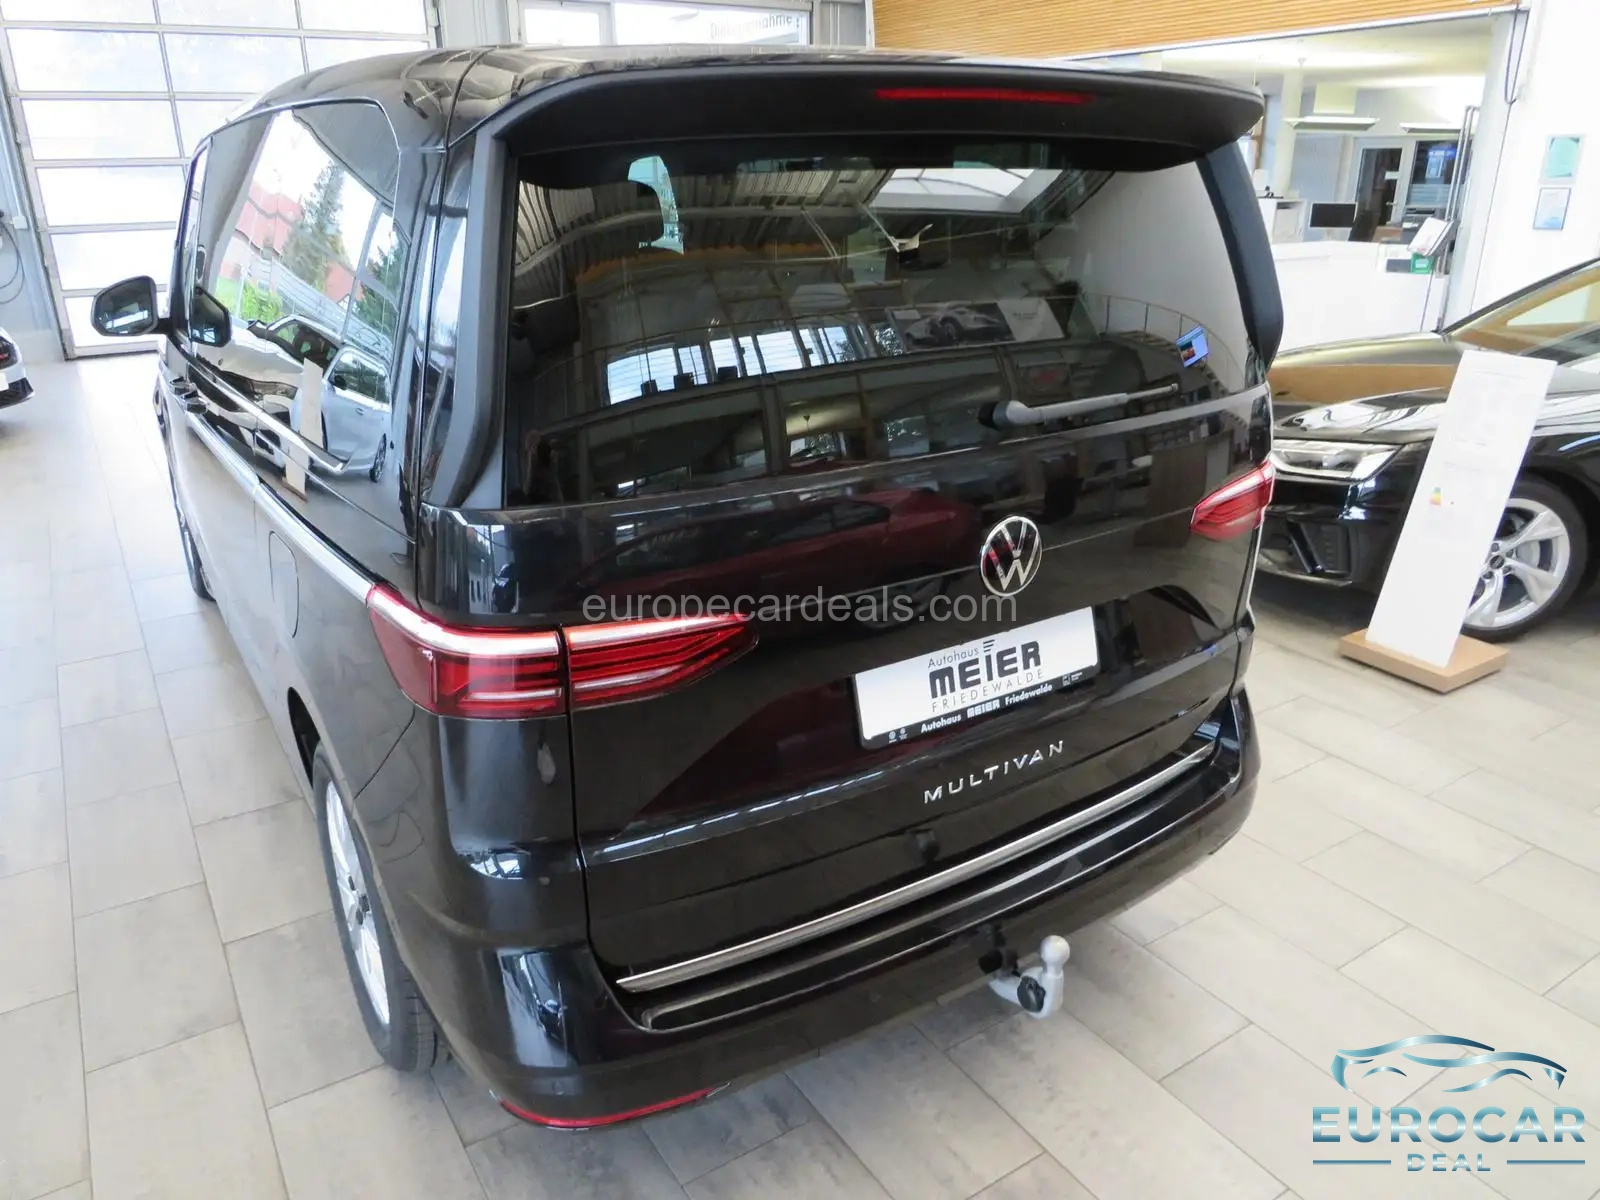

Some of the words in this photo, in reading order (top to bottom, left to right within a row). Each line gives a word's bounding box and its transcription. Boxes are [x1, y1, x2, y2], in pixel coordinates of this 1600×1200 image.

[928, 646, 980, 669] Autohaus
[929, 640, 1041, 699] MEIER
[921, 714, 962, 734] Autohaus
[967, 699, 1001, 719] MEIER
[1005, 684, 1053, 706] Friedewalde
[932, 669, 1044, 713] FRIEDEWALDE
[924, 740, 1063, 804] MULTIVAN
